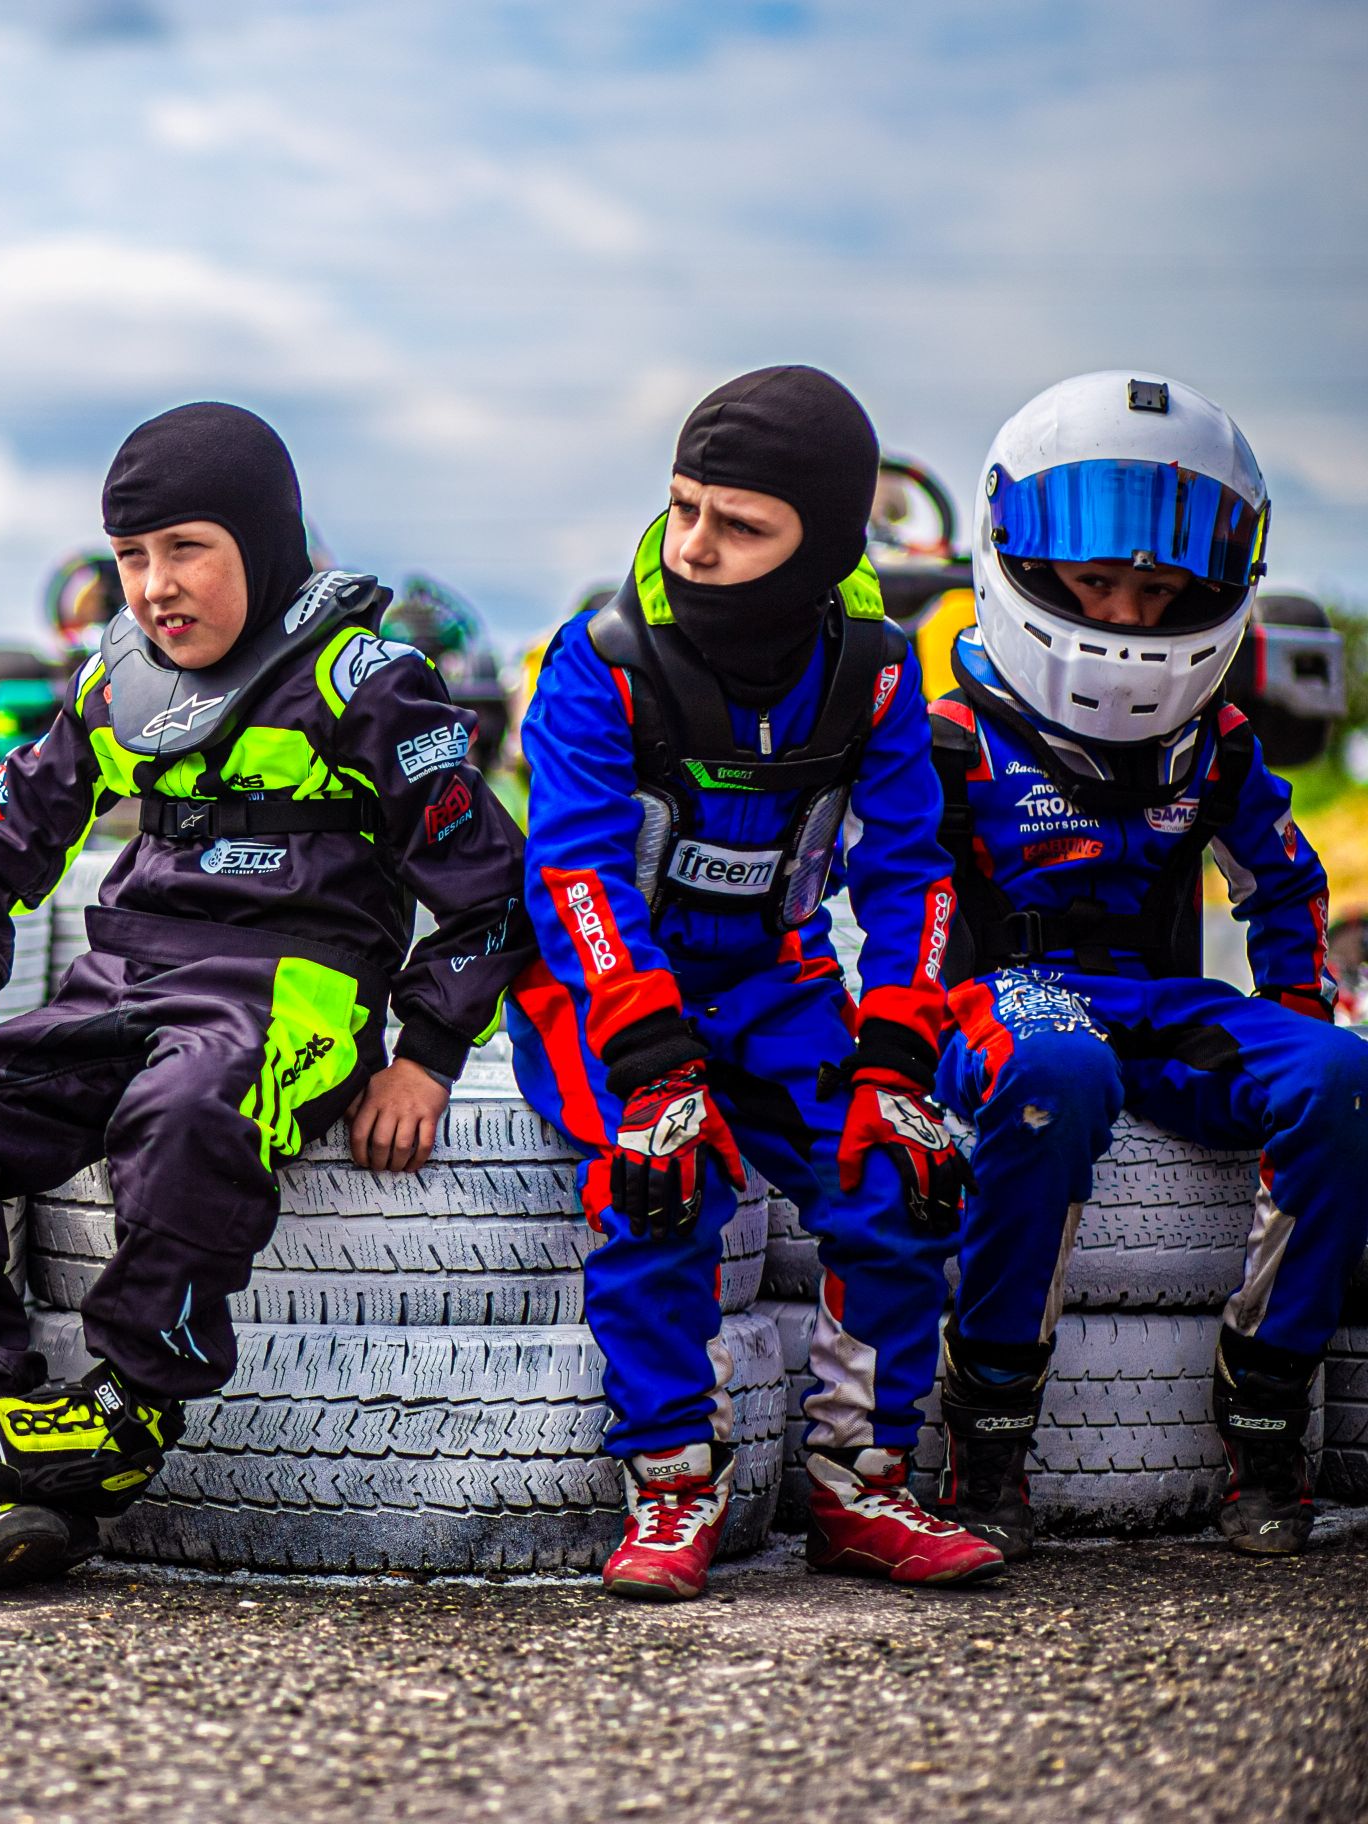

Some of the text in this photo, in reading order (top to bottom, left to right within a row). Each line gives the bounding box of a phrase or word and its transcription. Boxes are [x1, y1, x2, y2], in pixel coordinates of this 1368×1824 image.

[396, 722, 469, 760] PEGA
[405, 741, 468, 770] PLAST
[432, 784, 470, 833] RED
[1151, 806, 1198, 823] SAMS
[437, 809, 473, 841] DESIGN
[1020, 819, 1100, 833] motorsport
[223, 849, 287, 869] STK
[679, 845, 774, 886] freem
[567, 882, 617, 974] sparco
[925, 892, 952, 982] sparco
[98, 1384, 120, 1411] OMP
[976, 1415, 1034, 1430] alpinest
[646, 1461, 690, 1475] sparco
